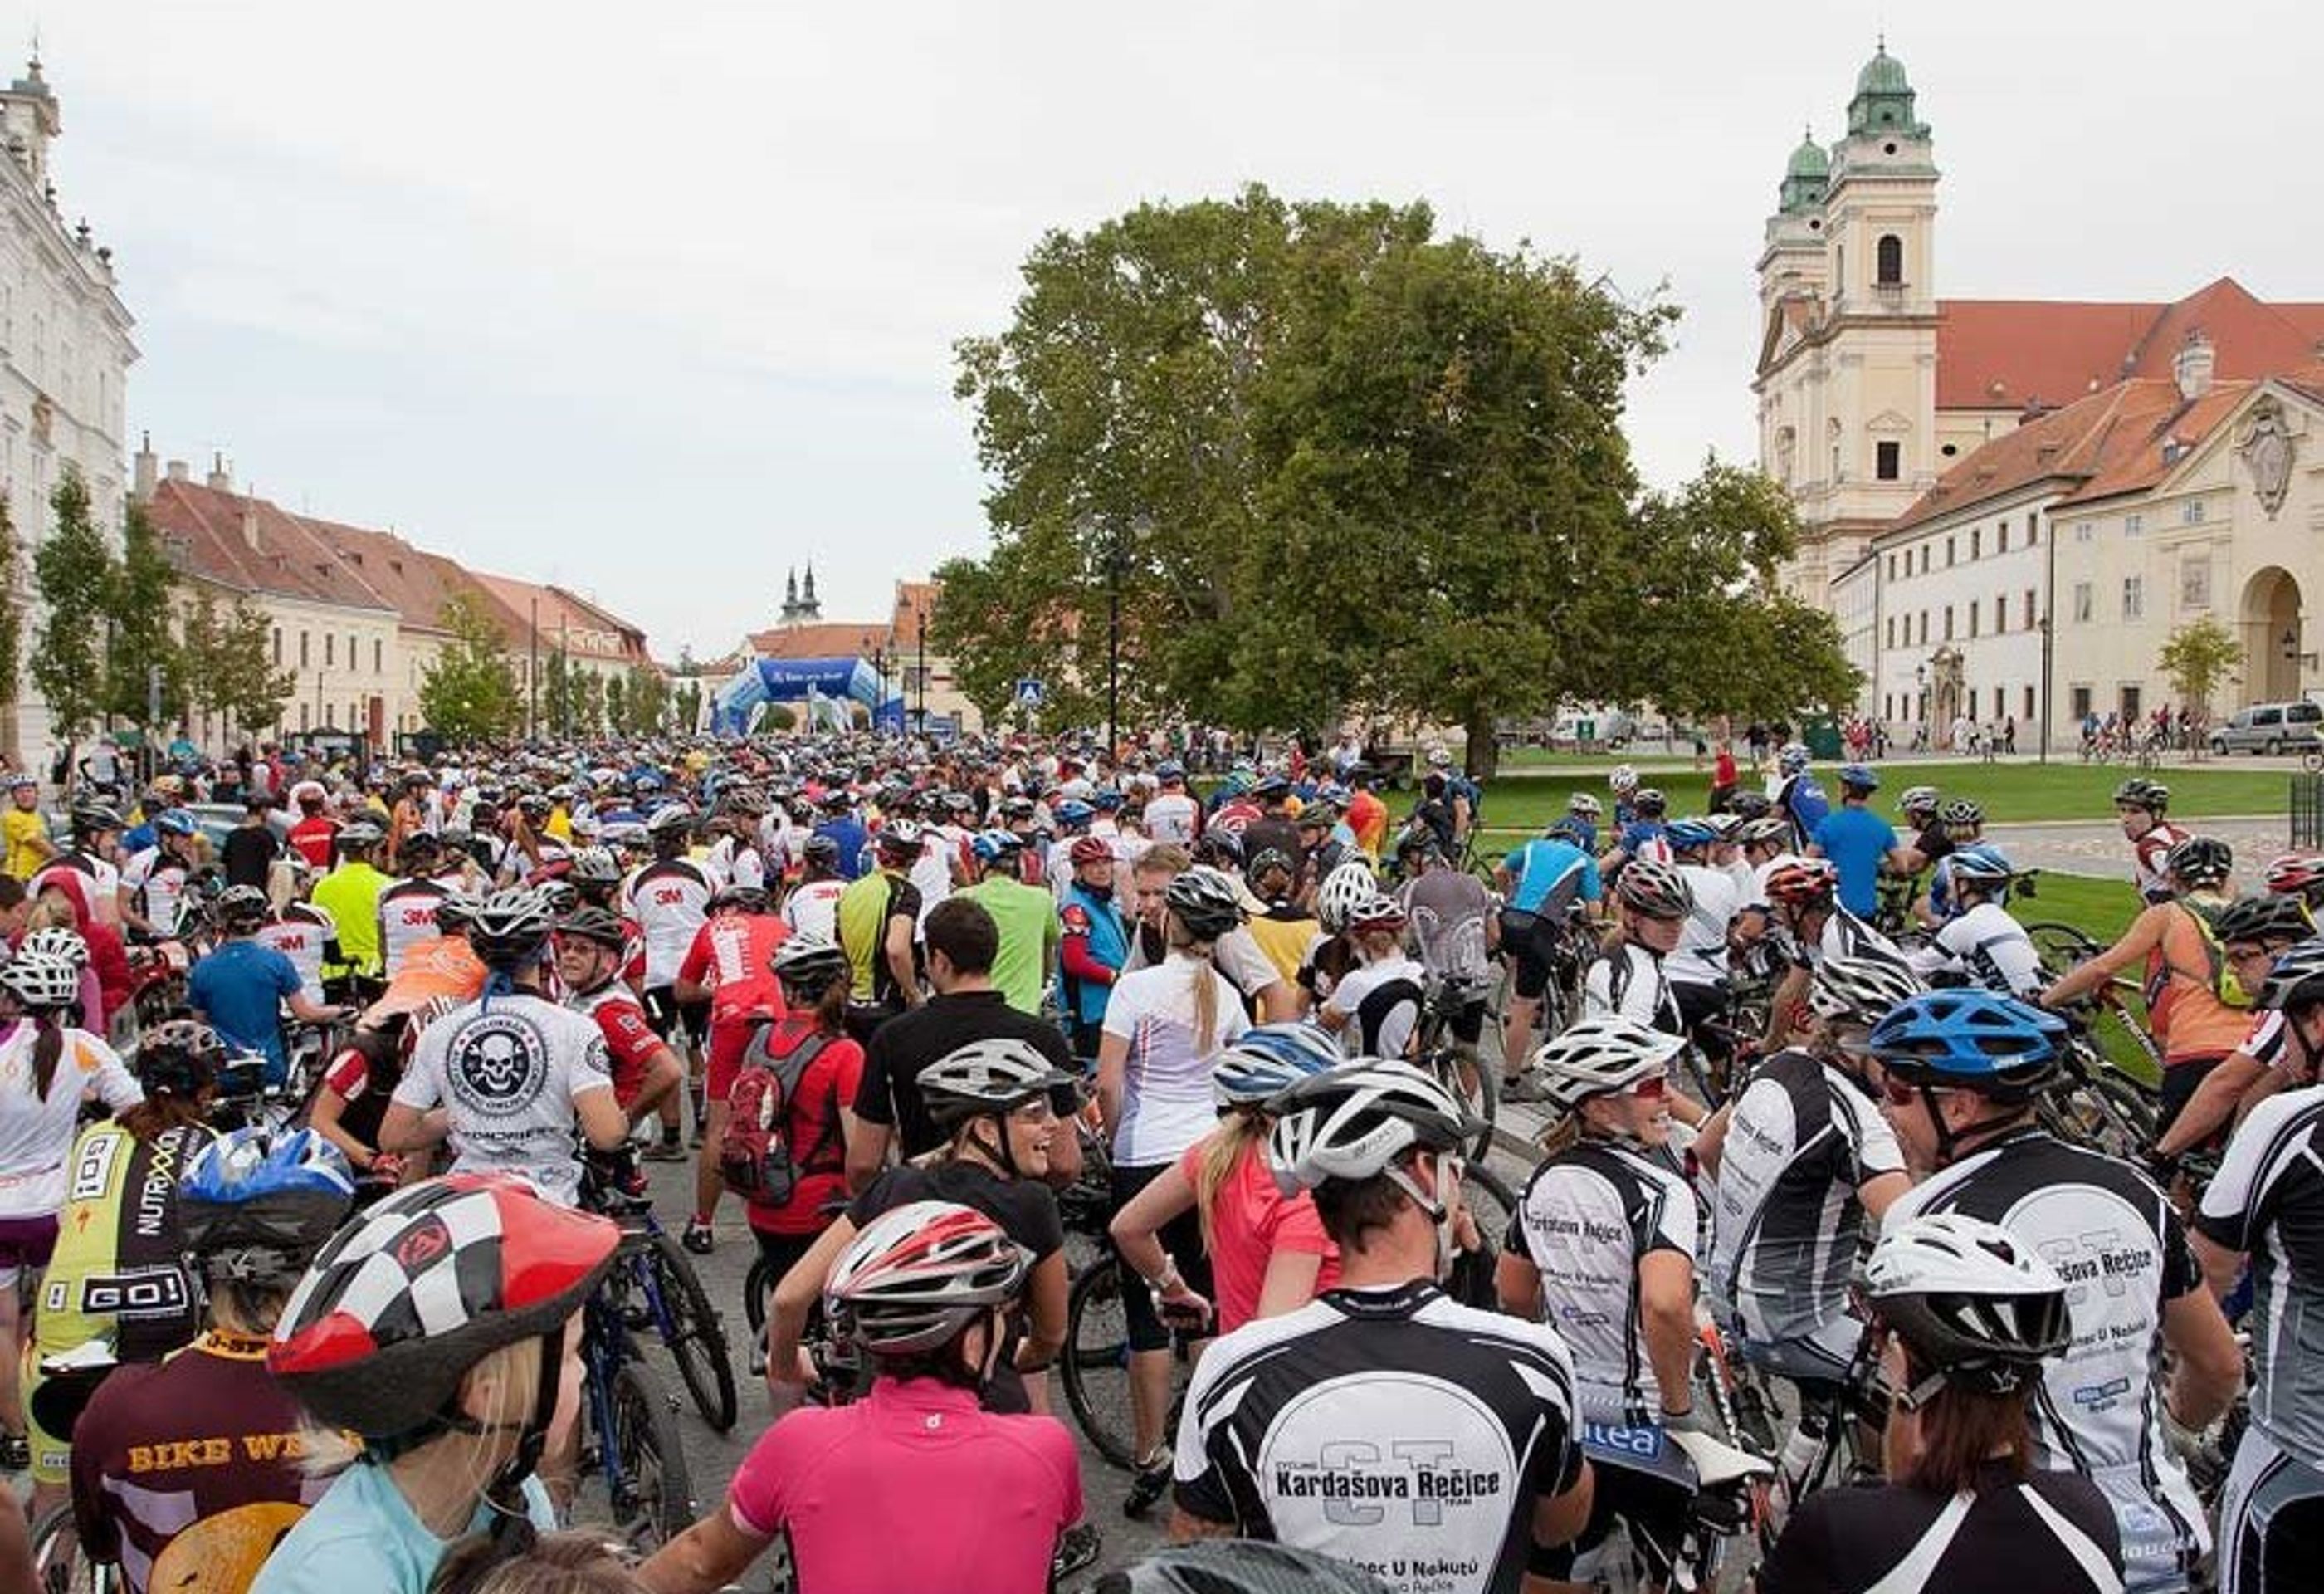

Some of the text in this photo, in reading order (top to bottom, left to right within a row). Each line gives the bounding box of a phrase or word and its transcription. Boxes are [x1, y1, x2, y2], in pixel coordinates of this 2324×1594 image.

[655, 889, 684, 905] 3M
[403, 909, 437, 926] 3M
[273, 935, 304, 950] 3M
[89, 1278, 179, 1308] GO!
[128, 1436, 232, 1474] BIKE
[1276, 1470, 1409, 1499] Kardašova
[1392, 1561, 1407, 1577] U
